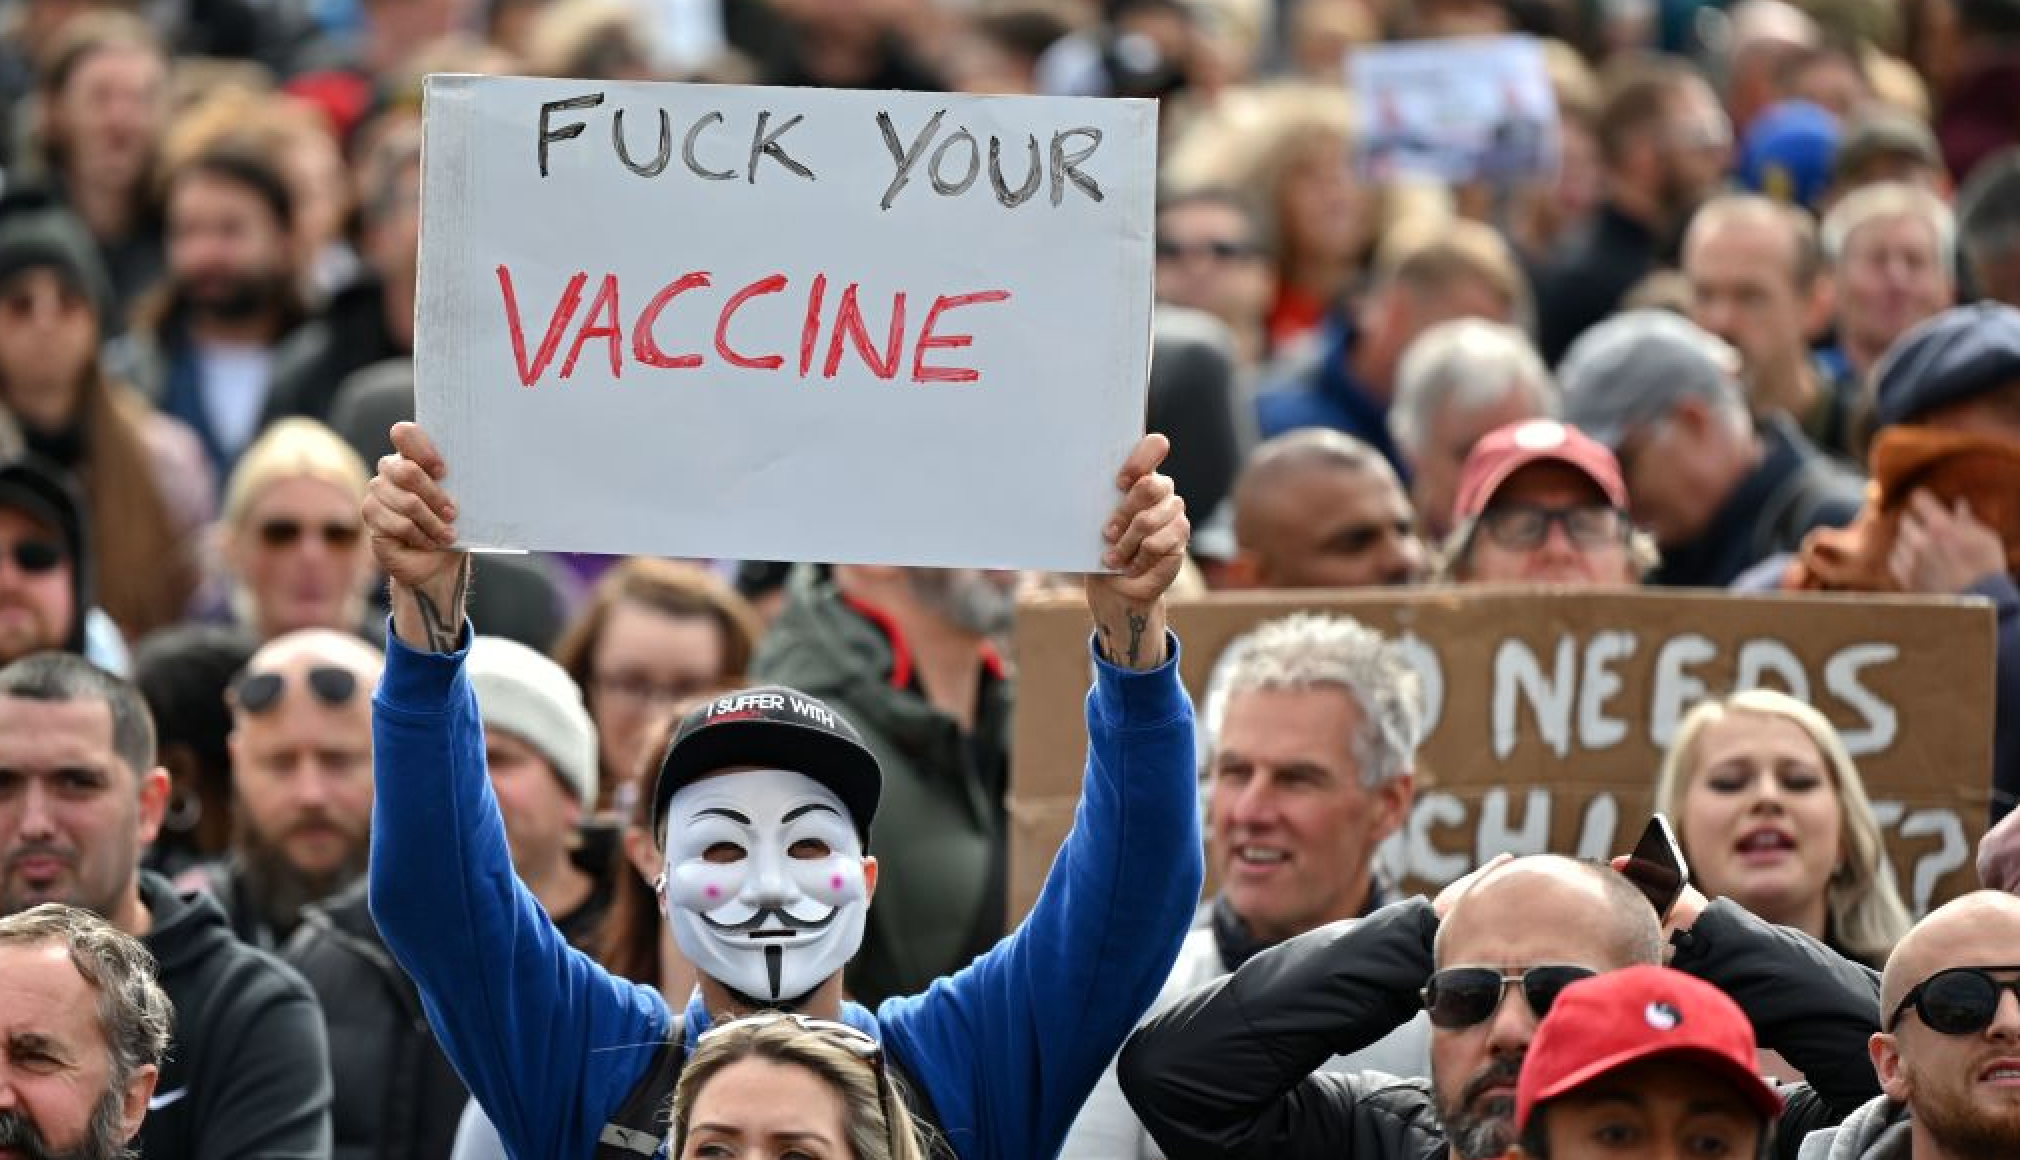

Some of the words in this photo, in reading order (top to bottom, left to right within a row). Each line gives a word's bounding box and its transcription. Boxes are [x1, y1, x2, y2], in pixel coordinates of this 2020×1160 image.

[537, 91, 817, 185] FUCK
[876, 109, 1105, 210] YOUR
[497, 264, 1011, 388] VACCINE
[706, 702, 715, 718] I
[716, 694, 785, 715] SUFFER
[789, 695, 835, 729] WITH
